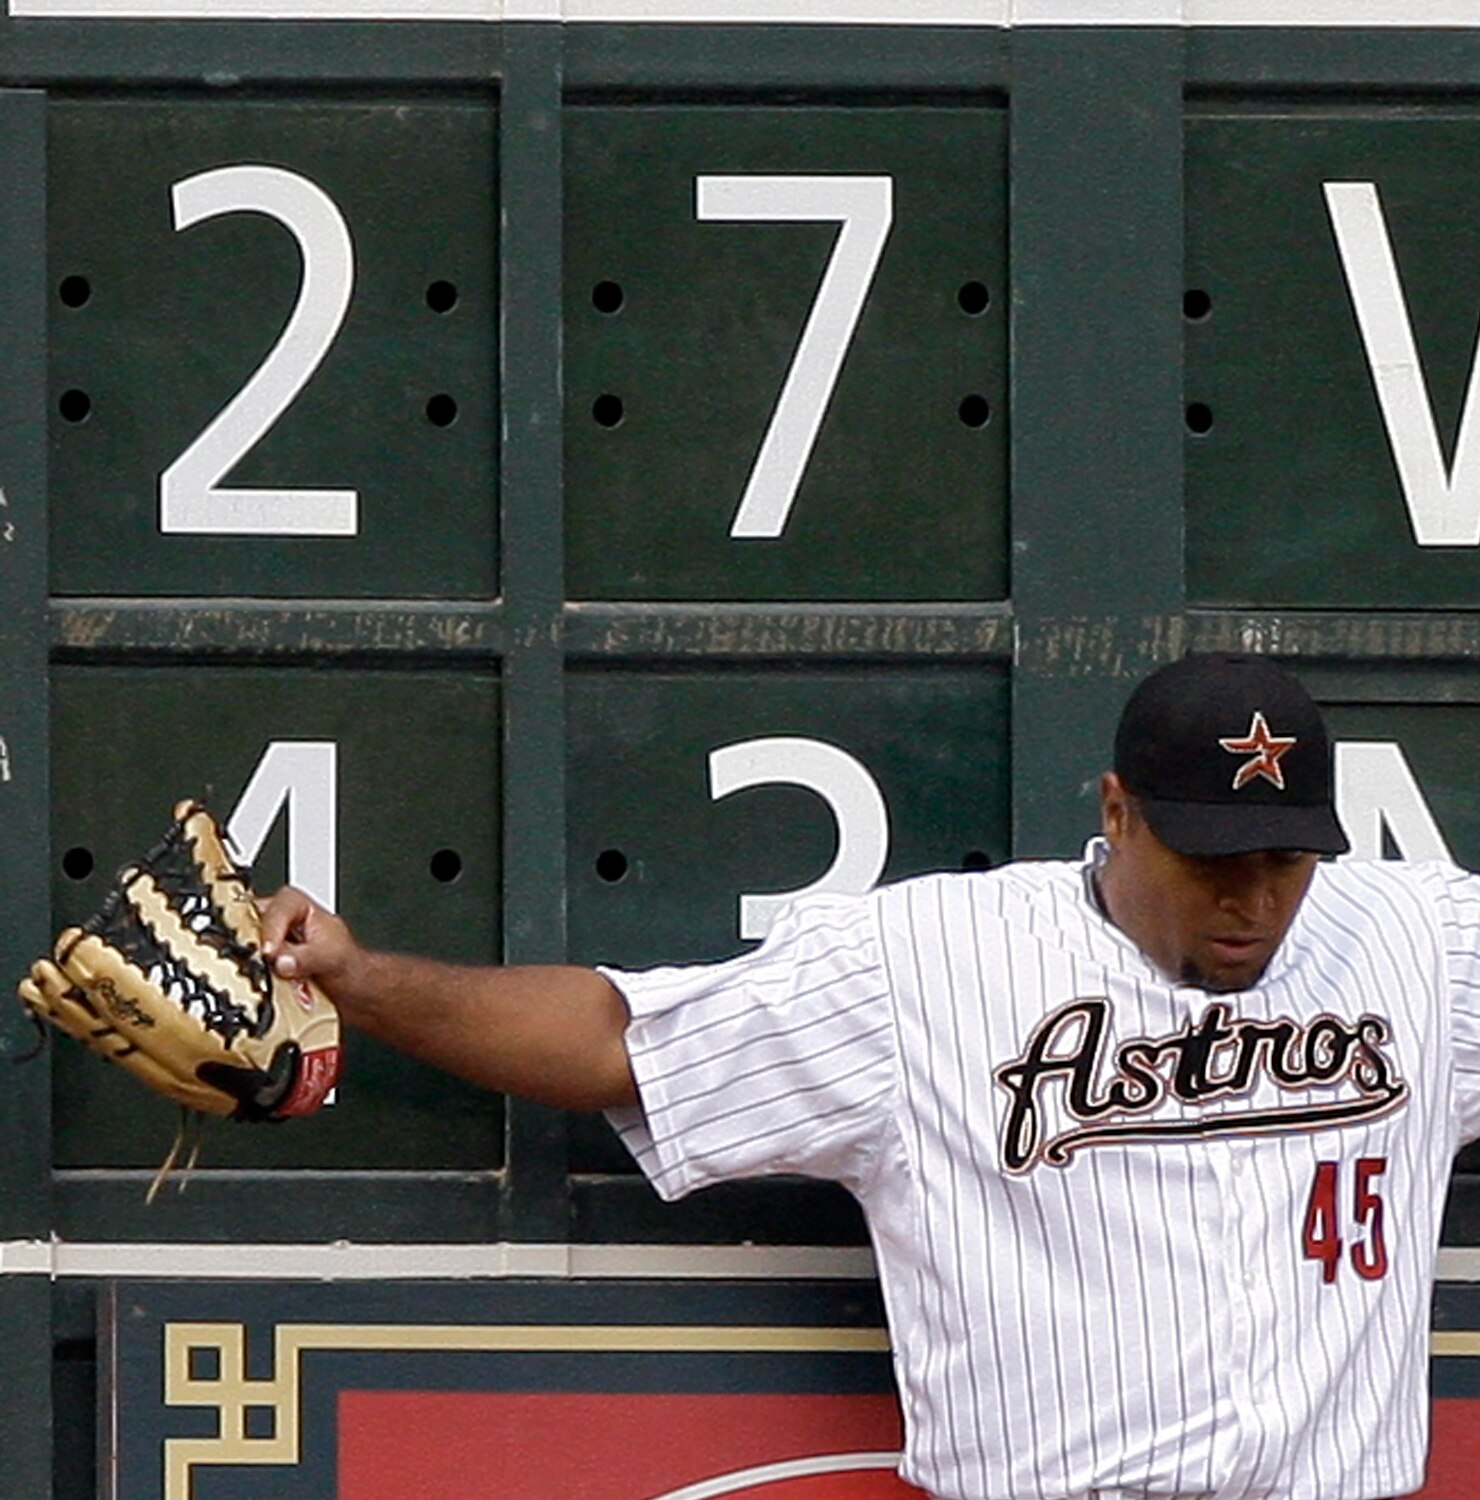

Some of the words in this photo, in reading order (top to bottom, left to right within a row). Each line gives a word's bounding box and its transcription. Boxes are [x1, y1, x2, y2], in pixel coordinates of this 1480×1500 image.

[159, 165, 359, 536] 2
[696, 175, 893, 538] 7
[994, 996, 1408, 1178] Astros
[1301, 1157, 1388, 1285] 45
